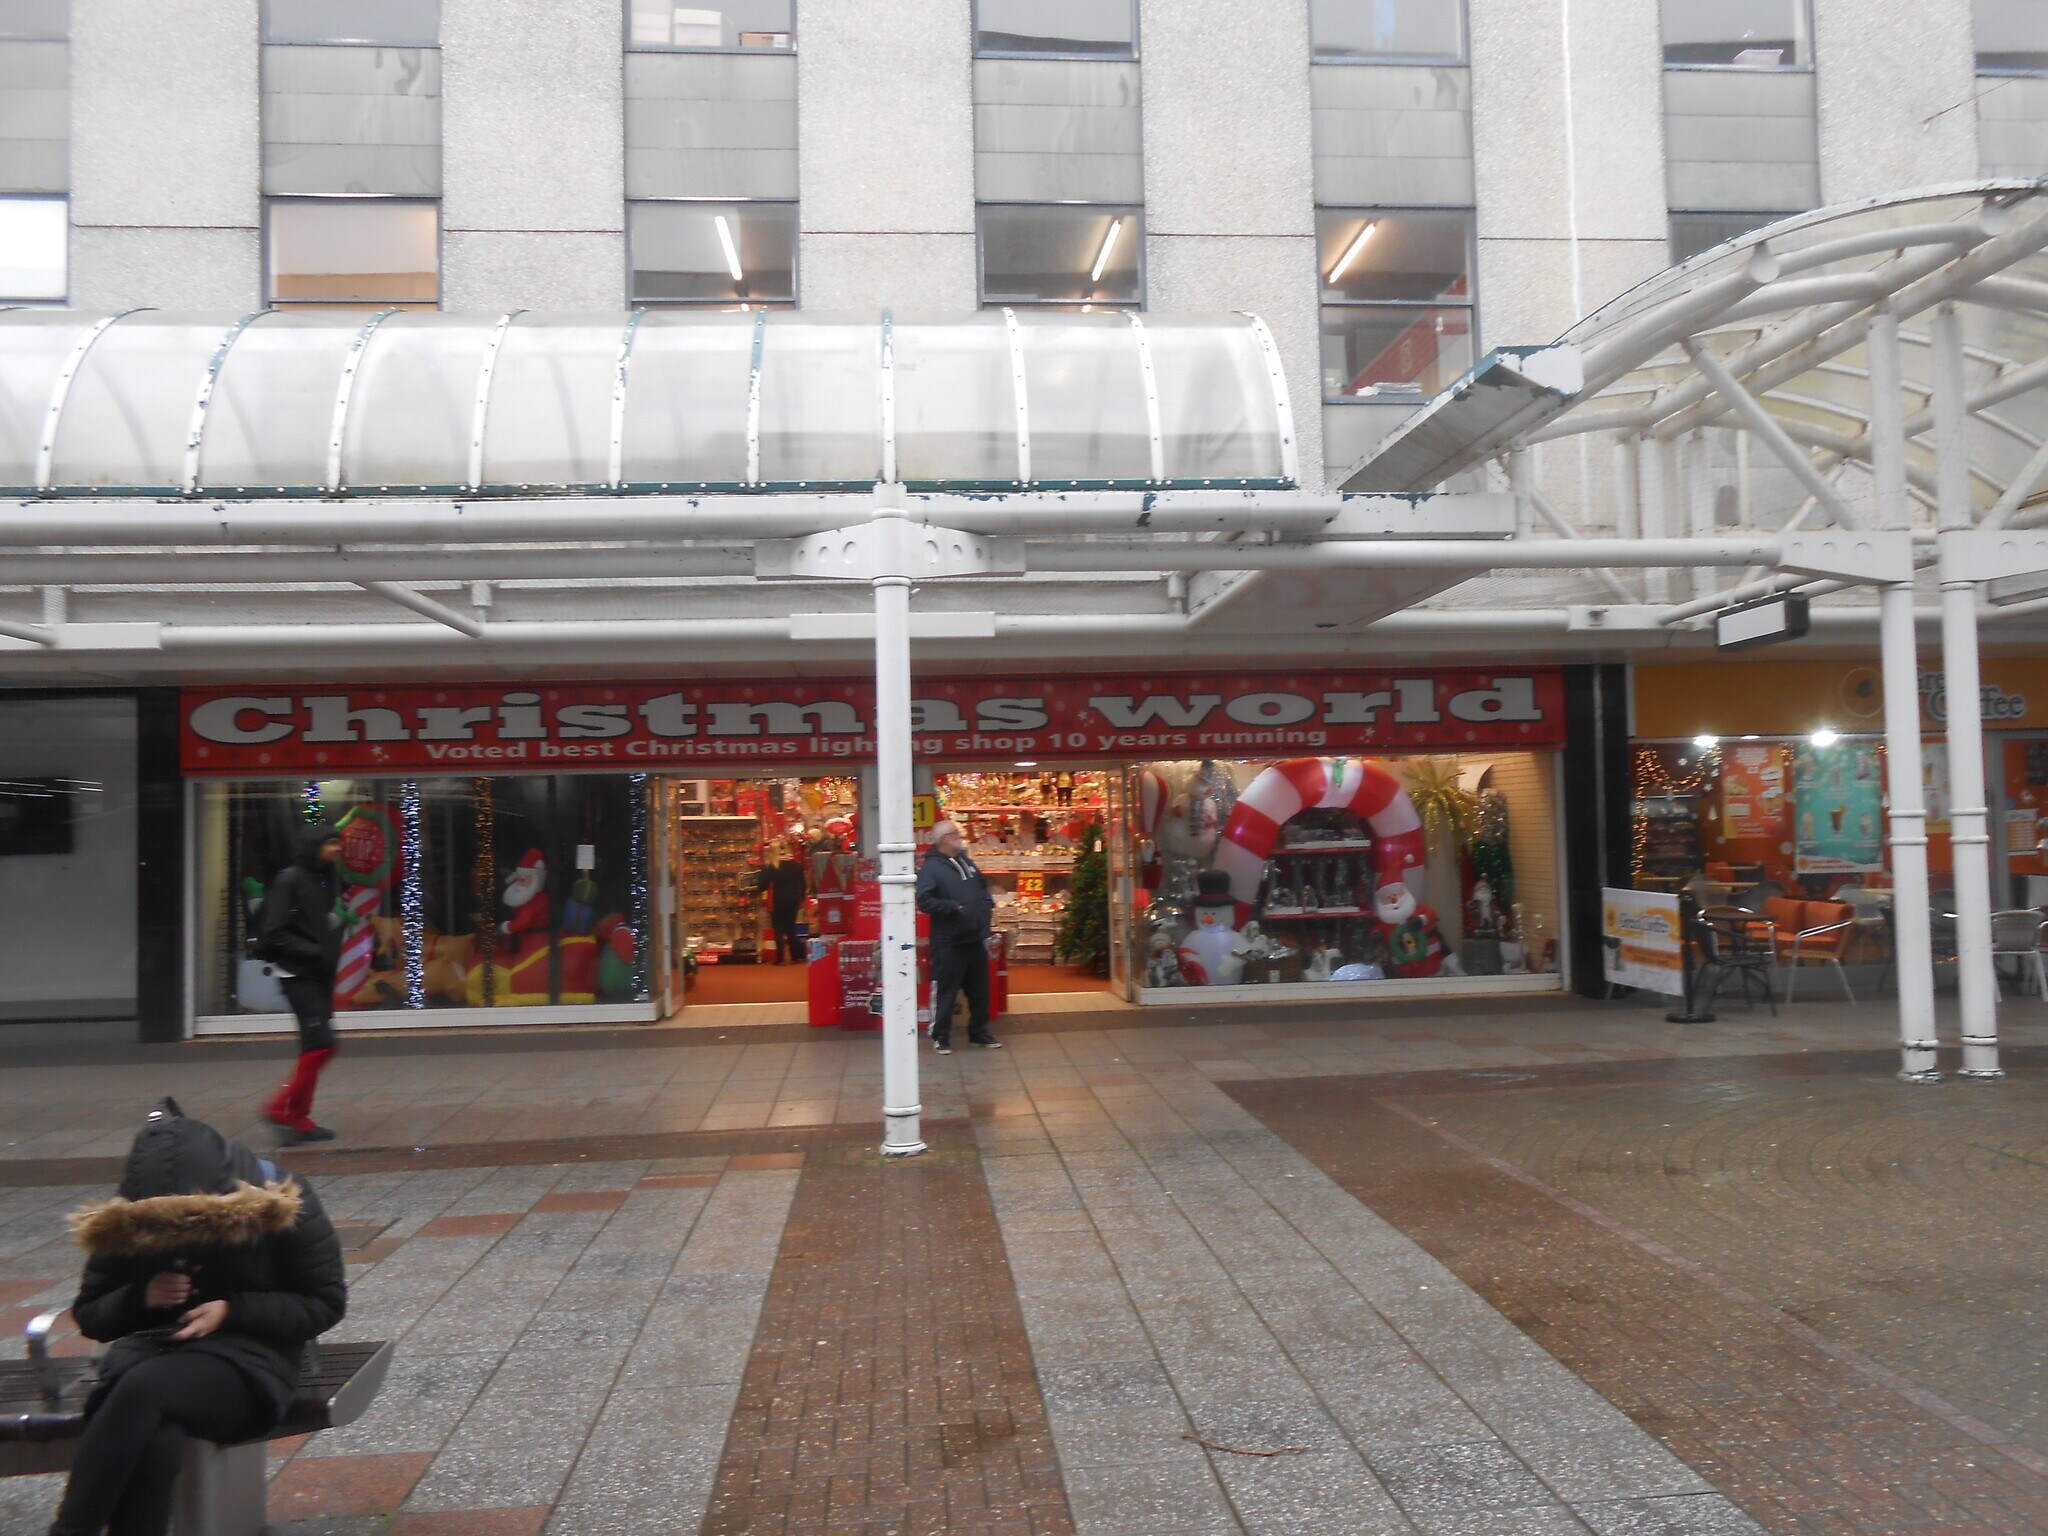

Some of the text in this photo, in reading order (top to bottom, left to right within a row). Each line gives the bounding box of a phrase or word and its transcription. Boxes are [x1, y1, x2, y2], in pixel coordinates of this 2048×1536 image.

[190, 677, 1543, 744] Christmas world
[1927, 686, 2026, 719] Cfee
[425, 727, 1328, 760] Voted best Christmas lighg shop 10 years running
